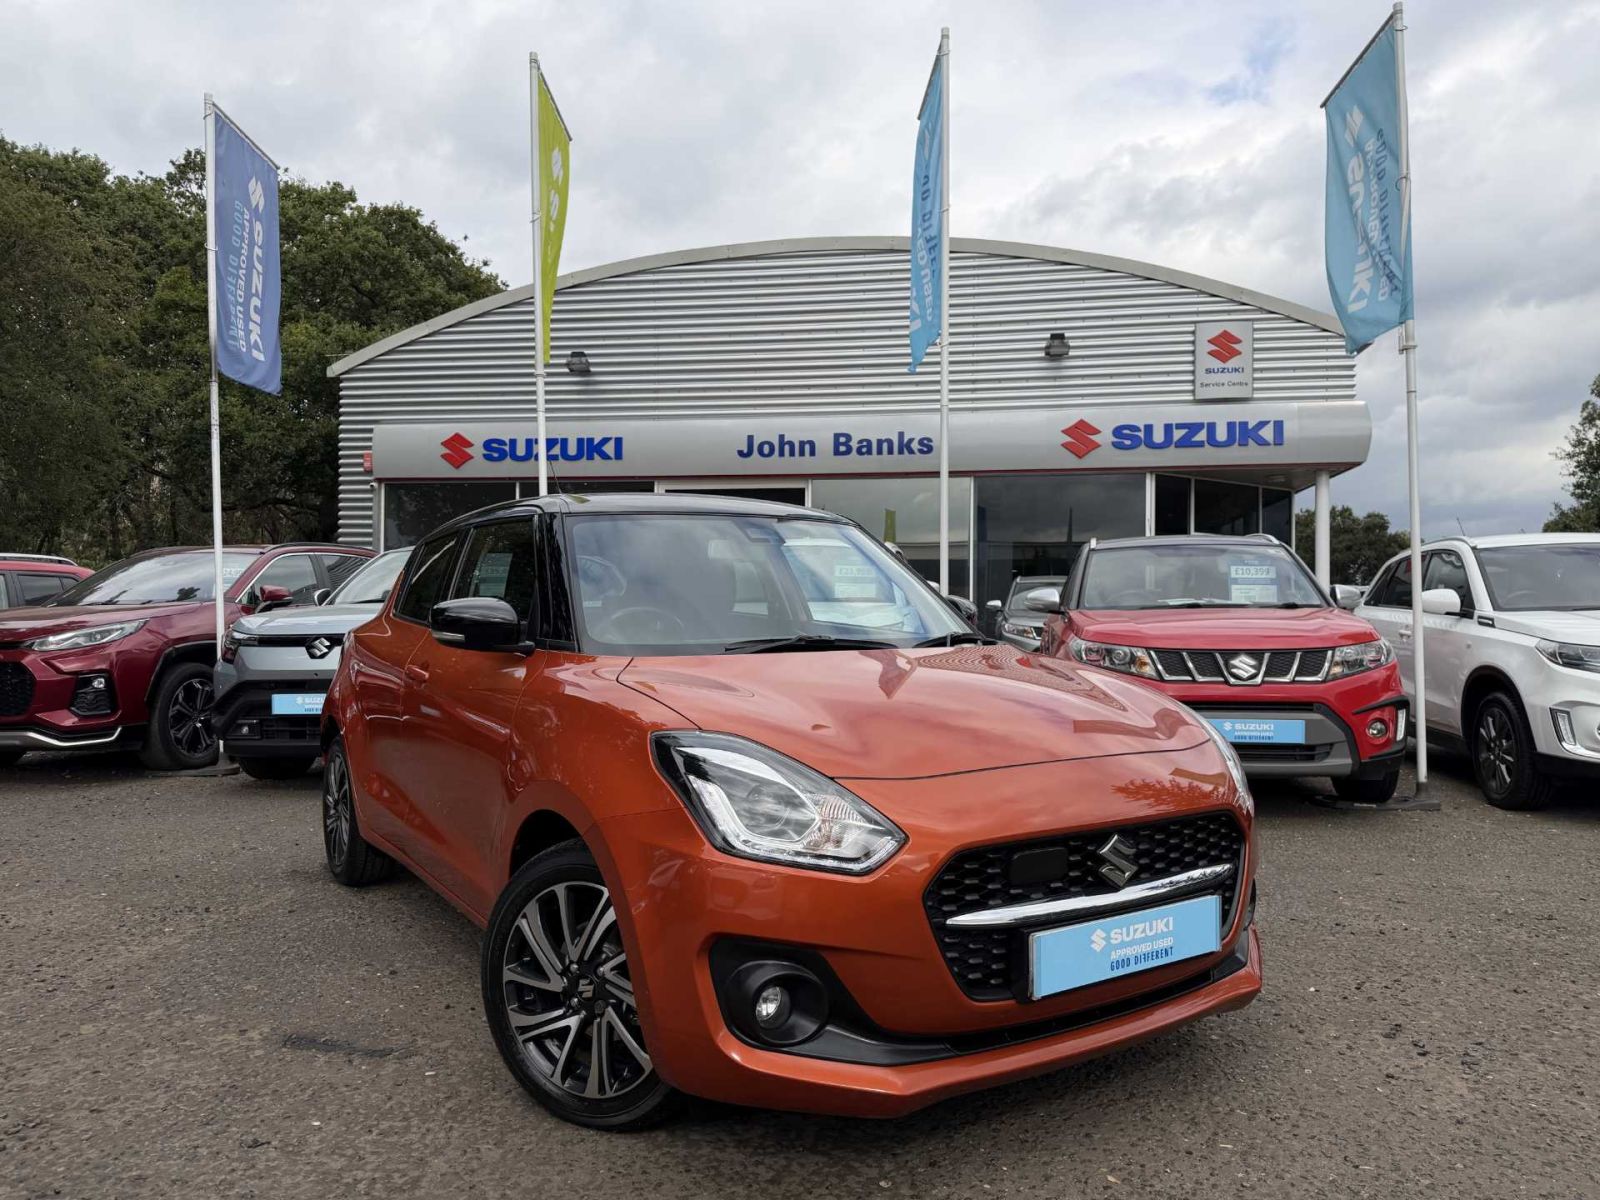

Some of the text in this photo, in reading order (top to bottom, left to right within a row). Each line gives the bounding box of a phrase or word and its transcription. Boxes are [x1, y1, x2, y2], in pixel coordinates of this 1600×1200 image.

[231, 200, 243, 247] GOOD
[236, 207, 250, 352] APPROVED USED
[248, 218, 266, 362] SUZUKI
[736, 431, 934, 458] John Banks
[1111, 420, 1284, 450] SUZUKI
[482, 436, 623, 462] SUZUKI
[1234, 723, 1274, 731] SUZUKI
[1110, 917, 1174, 945] SUZUKI
[1110, 937, 1174, 960] APPROVED USED
[1110, 946, 1174, 971] GOOD DIFFERENT
